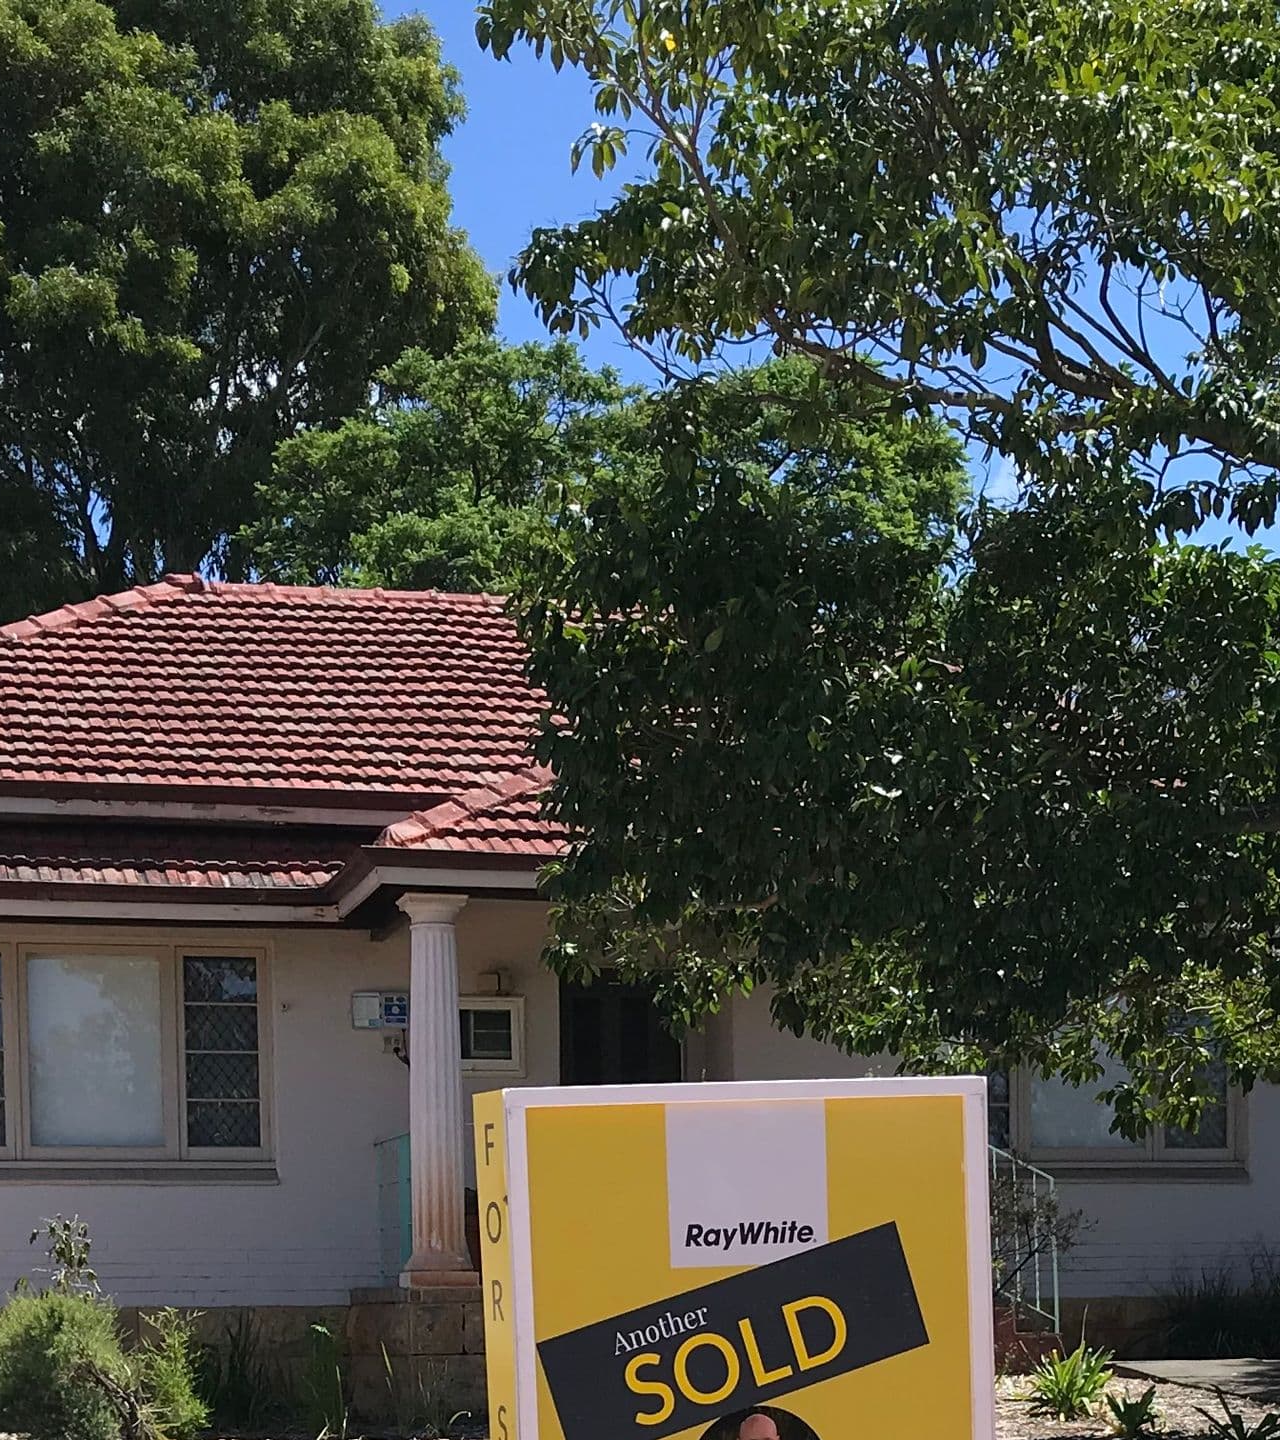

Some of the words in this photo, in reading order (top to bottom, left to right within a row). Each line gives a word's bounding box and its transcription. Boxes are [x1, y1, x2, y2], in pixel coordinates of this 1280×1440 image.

[484, 1122, 505, 1322] FOR
[614, 1306, 708, 1356] Another
[624, 1296, 847, 1425] SOLD
